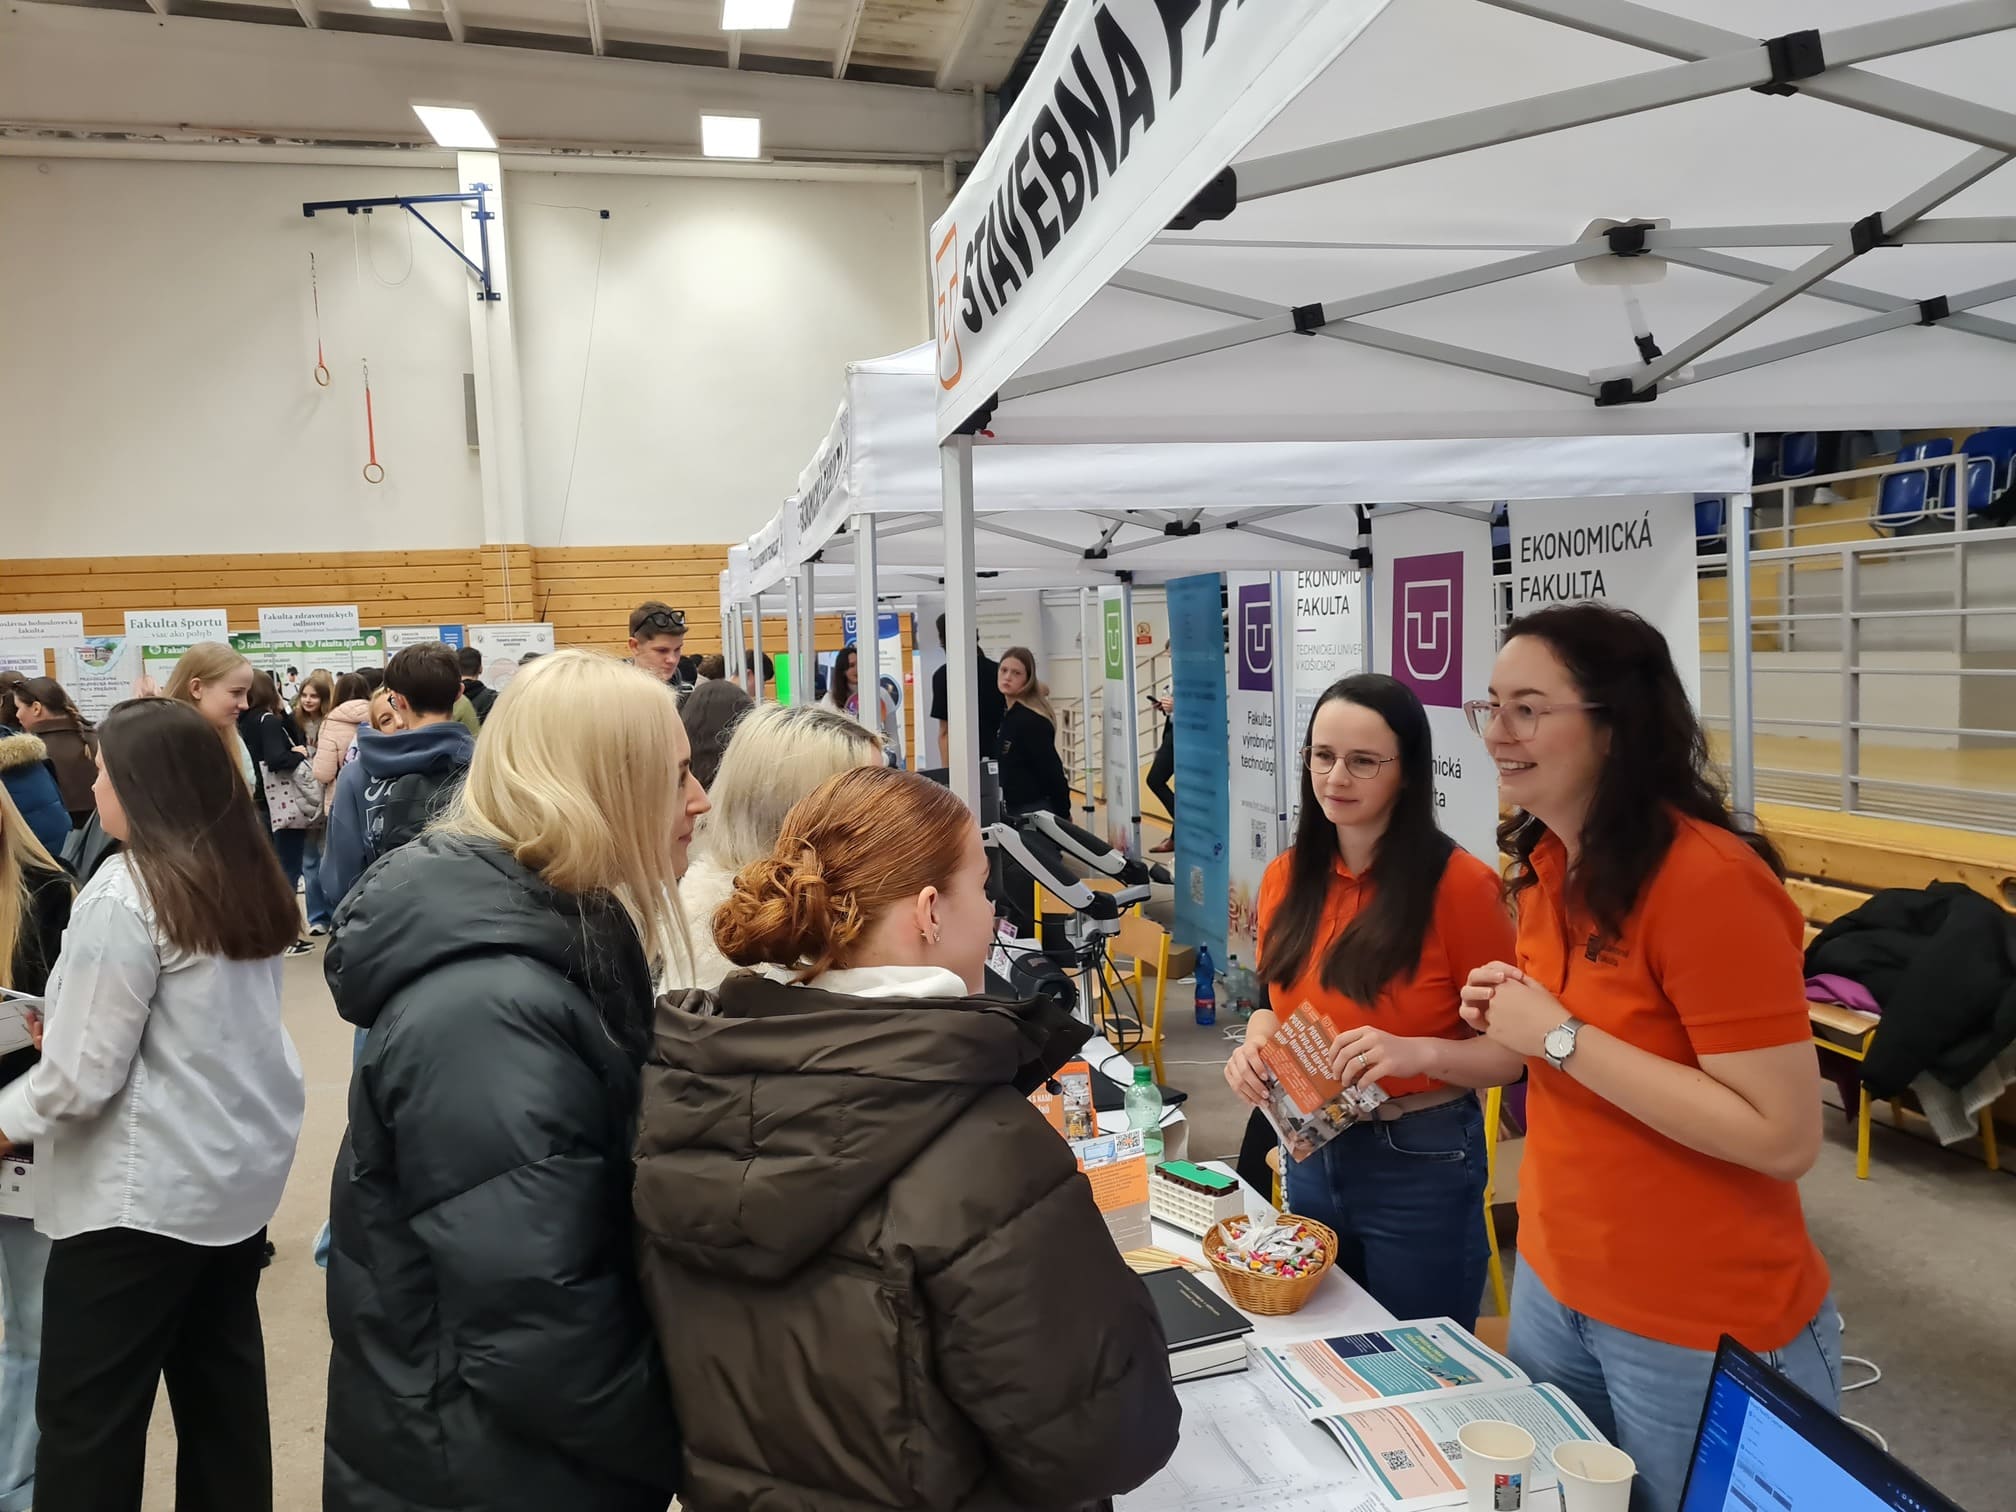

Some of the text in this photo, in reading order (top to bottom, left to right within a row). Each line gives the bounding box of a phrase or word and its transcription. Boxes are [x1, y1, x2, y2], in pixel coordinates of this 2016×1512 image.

[1520, 509, 1653, 563] EKONOMICKÁ
[1297, 570, 1361, 589] EKONOMIC
[1520, 569, 1606, 603] FAKULTA
[1297, 595, 1350, 617] FAKULTA
[130, 618, 222, 630] Fakulta športu
[163, 646, 188, 655] Fakult
[1337, 642, 1362, 656] UNIVER
[1248, 711, 1272, 727] Fakulta
[1241, 754, 1275, 776] technológ
[1431, 755, 1462, 779] nická
[1281, 1022, 1296, 1039] SVOJ
[1289, 1013, 1306, 1032] POSTA
